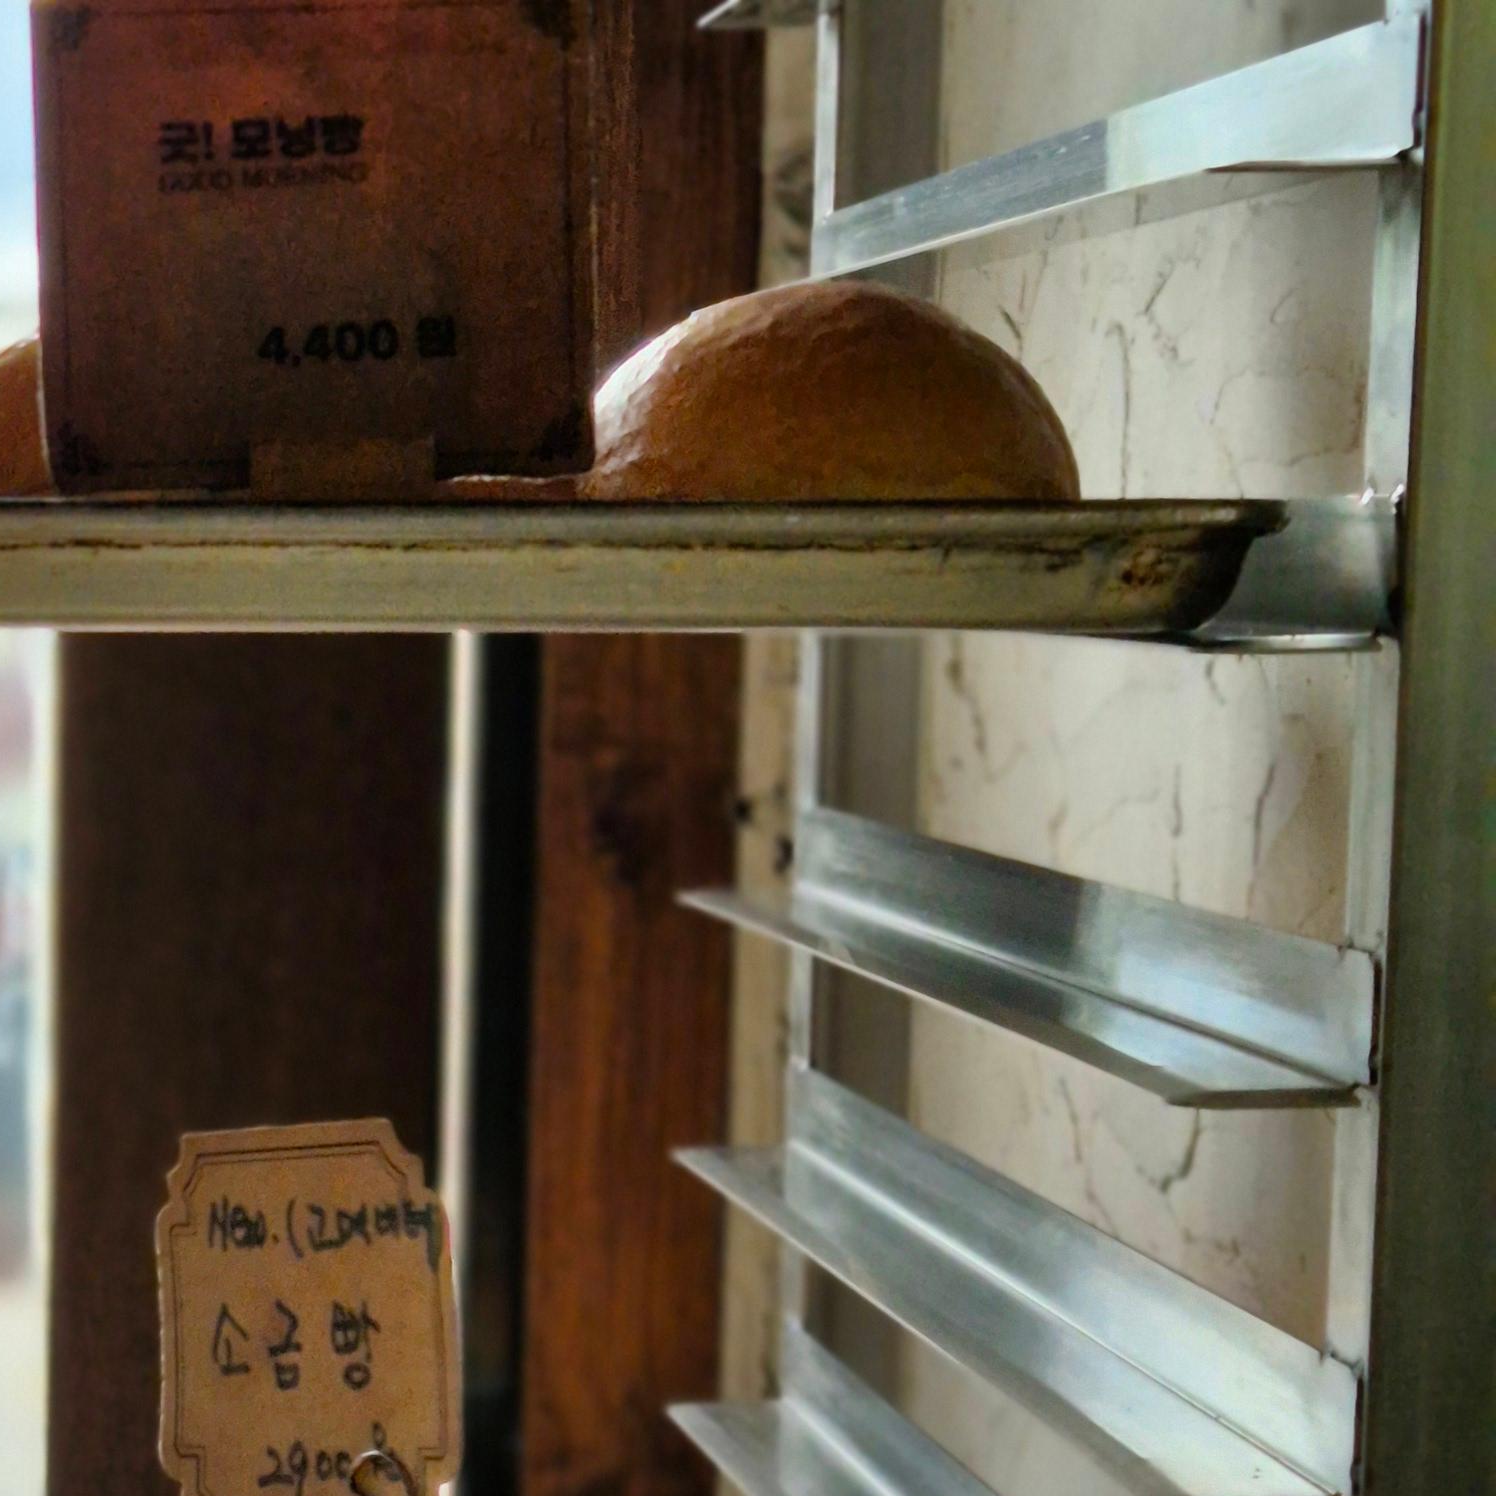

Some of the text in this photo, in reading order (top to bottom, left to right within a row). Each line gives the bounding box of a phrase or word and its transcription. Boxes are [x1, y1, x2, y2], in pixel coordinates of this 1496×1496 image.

[157, 113, 365, 165] 굿! 모닝빵
[415, 314, 457, 359] 원
[211, 1298, 382, 1391] 소금빵
